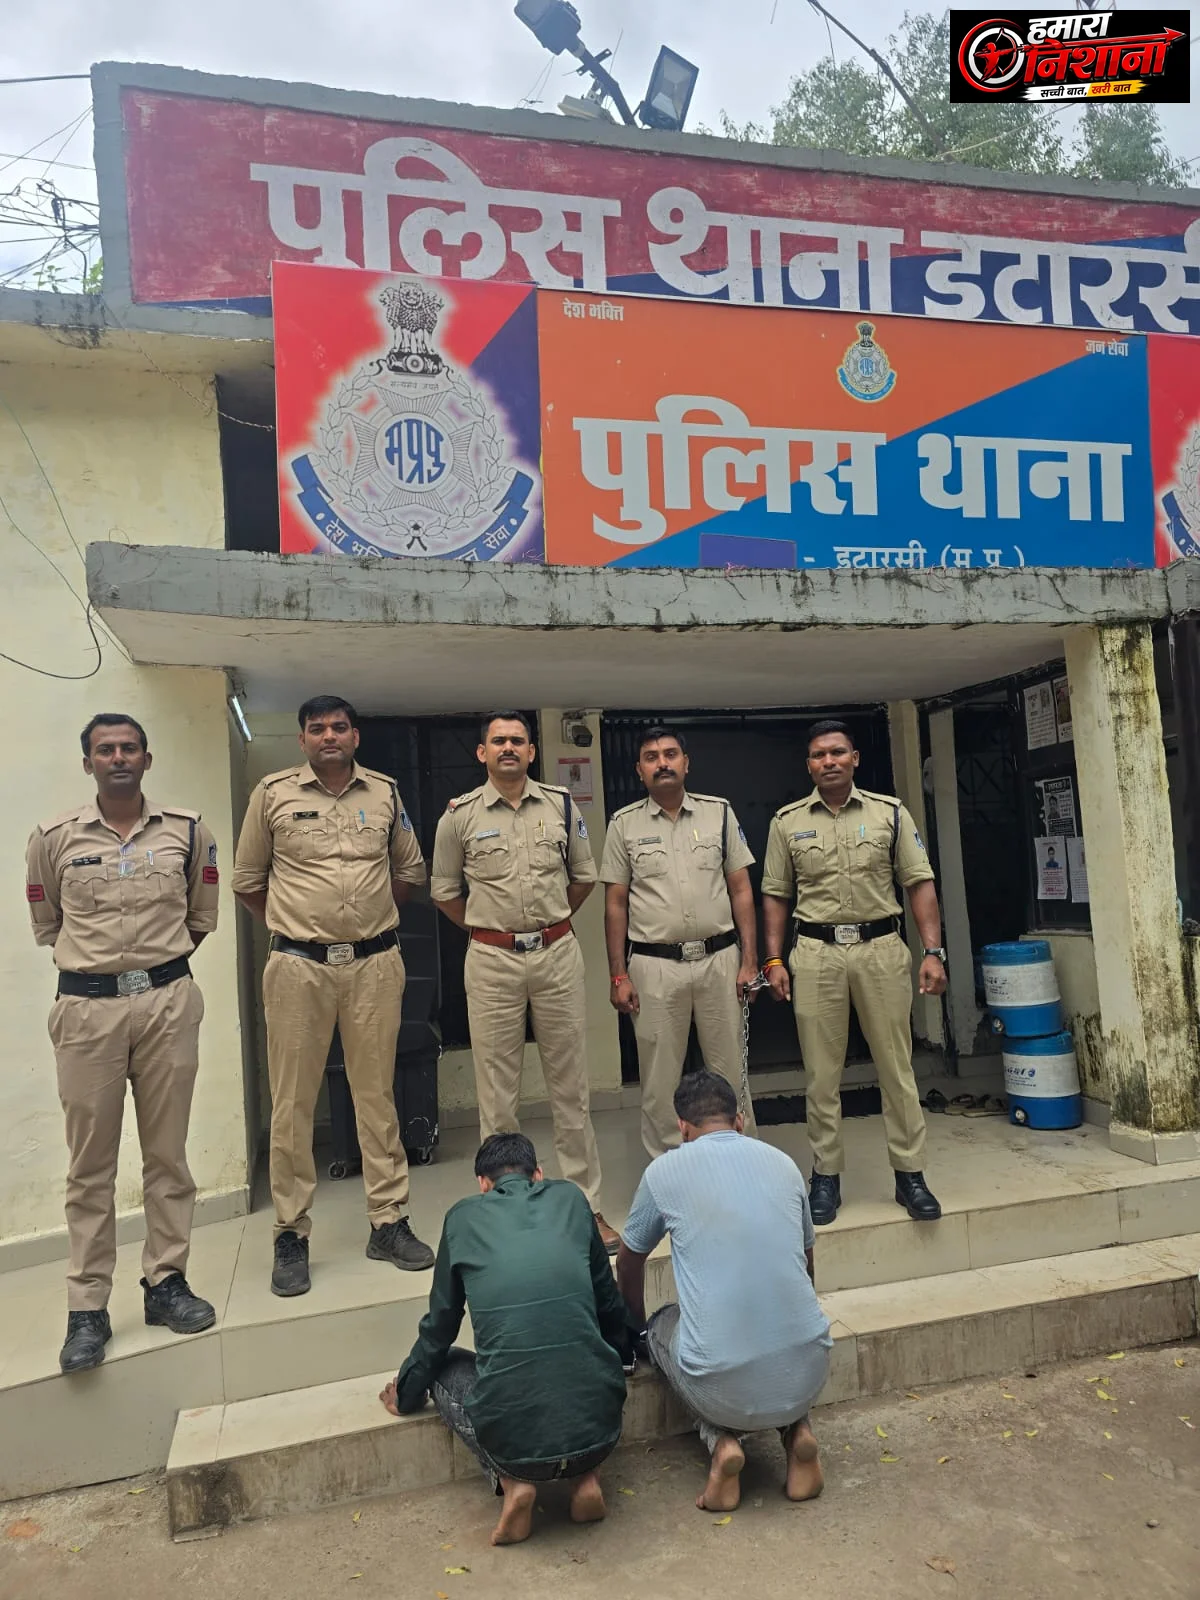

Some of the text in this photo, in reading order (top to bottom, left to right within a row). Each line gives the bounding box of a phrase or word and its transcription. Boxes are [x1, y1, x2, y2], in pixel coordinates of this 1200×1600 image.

[647, 186, 905, 311] थाना
[921, 218, 1200, 334] इटारस
[562, 297, 586, 319] देश
[1085, 337, 1129, 357] जन सेवा
[572, 394, 1133, 545] पुलिस थाना
[325, 518, 348, 544] देश
